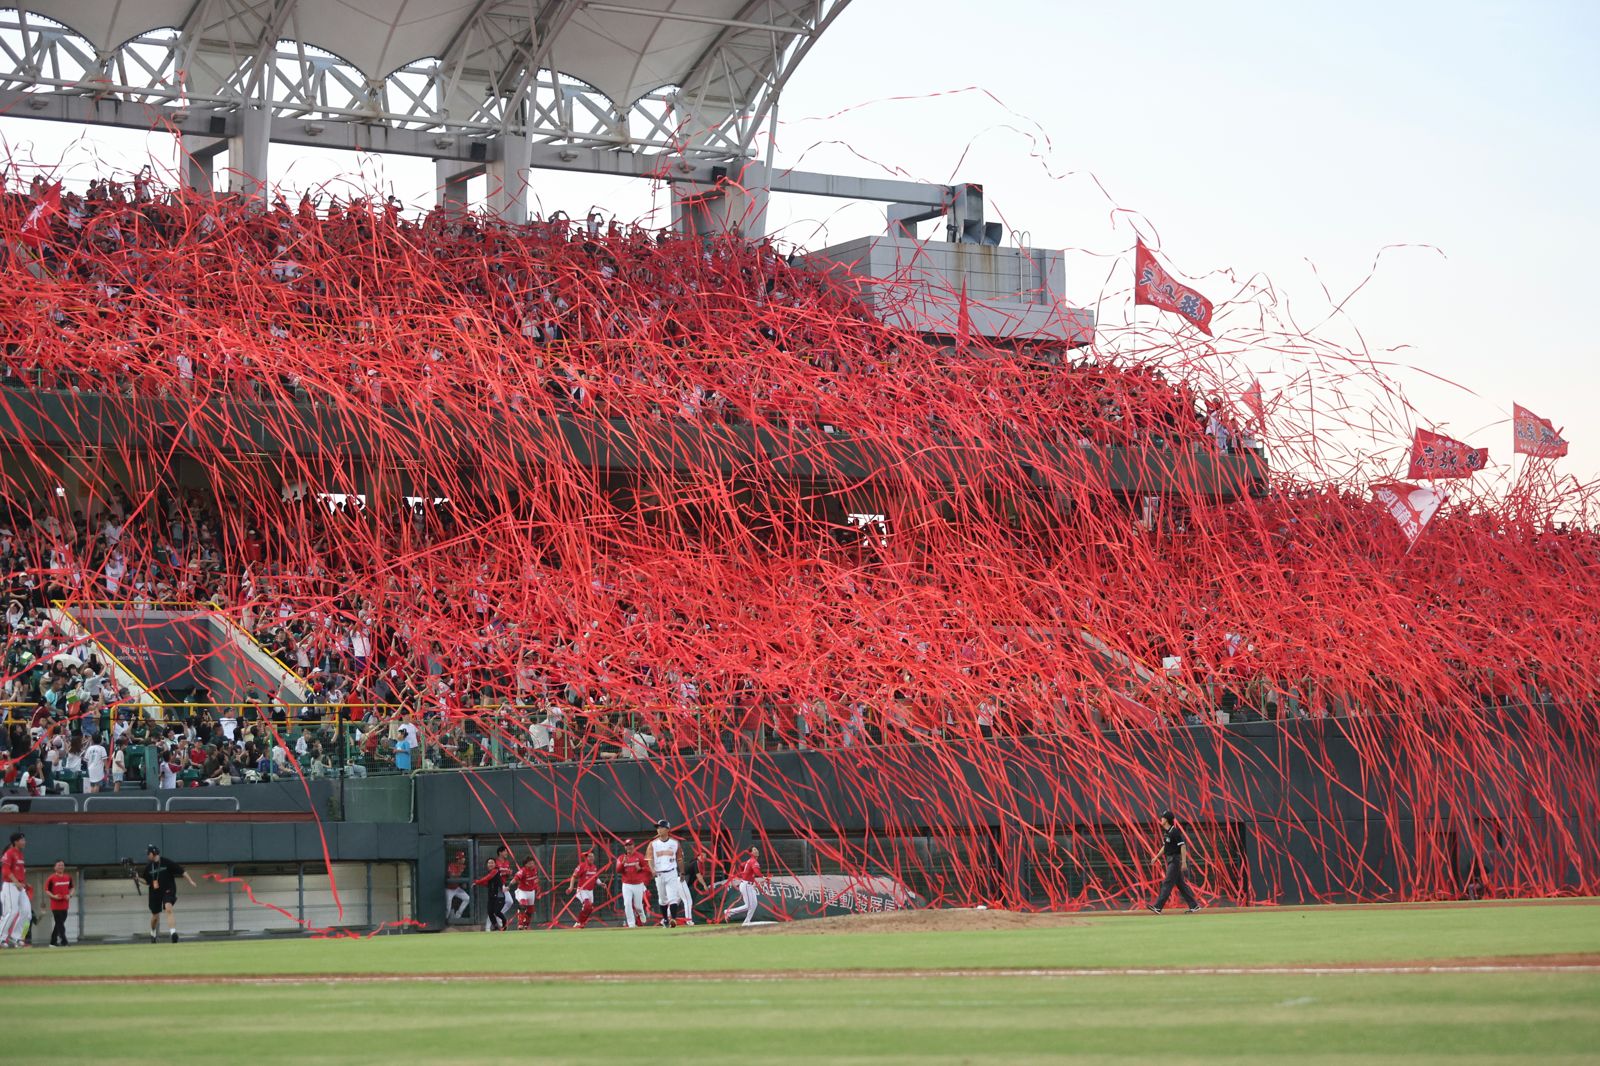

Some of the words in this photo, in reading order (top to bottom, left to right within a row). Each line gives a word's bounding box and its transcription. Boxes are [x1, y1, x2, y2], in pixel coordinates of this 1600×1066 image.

[755, 883, 896, 913] 雄市政府運動發展局
